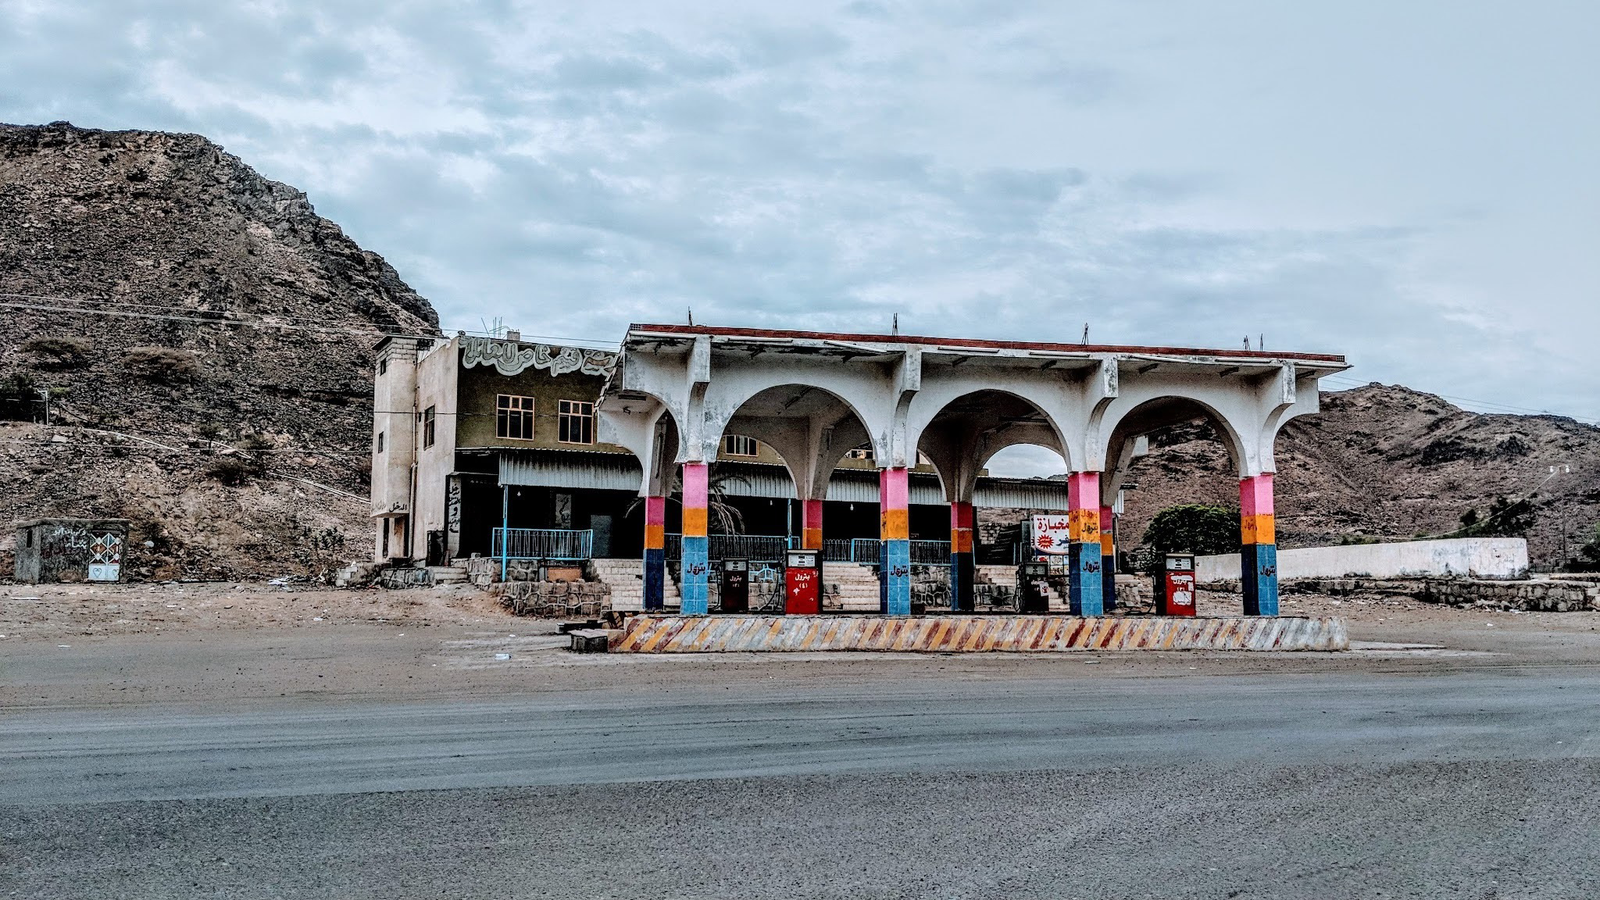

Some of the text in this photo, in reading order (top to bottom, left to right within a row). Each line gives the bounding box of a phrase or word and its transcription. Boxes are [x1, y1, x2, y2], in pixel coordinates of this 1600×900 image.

[687, 562, 706, 577] بترول
[890, 564, 909, 578] بترول
[1082, 561, 1100, 574] بترول
[1260, 564, 1276, 577] بترول
[794, 573, 811, 582] بترول
